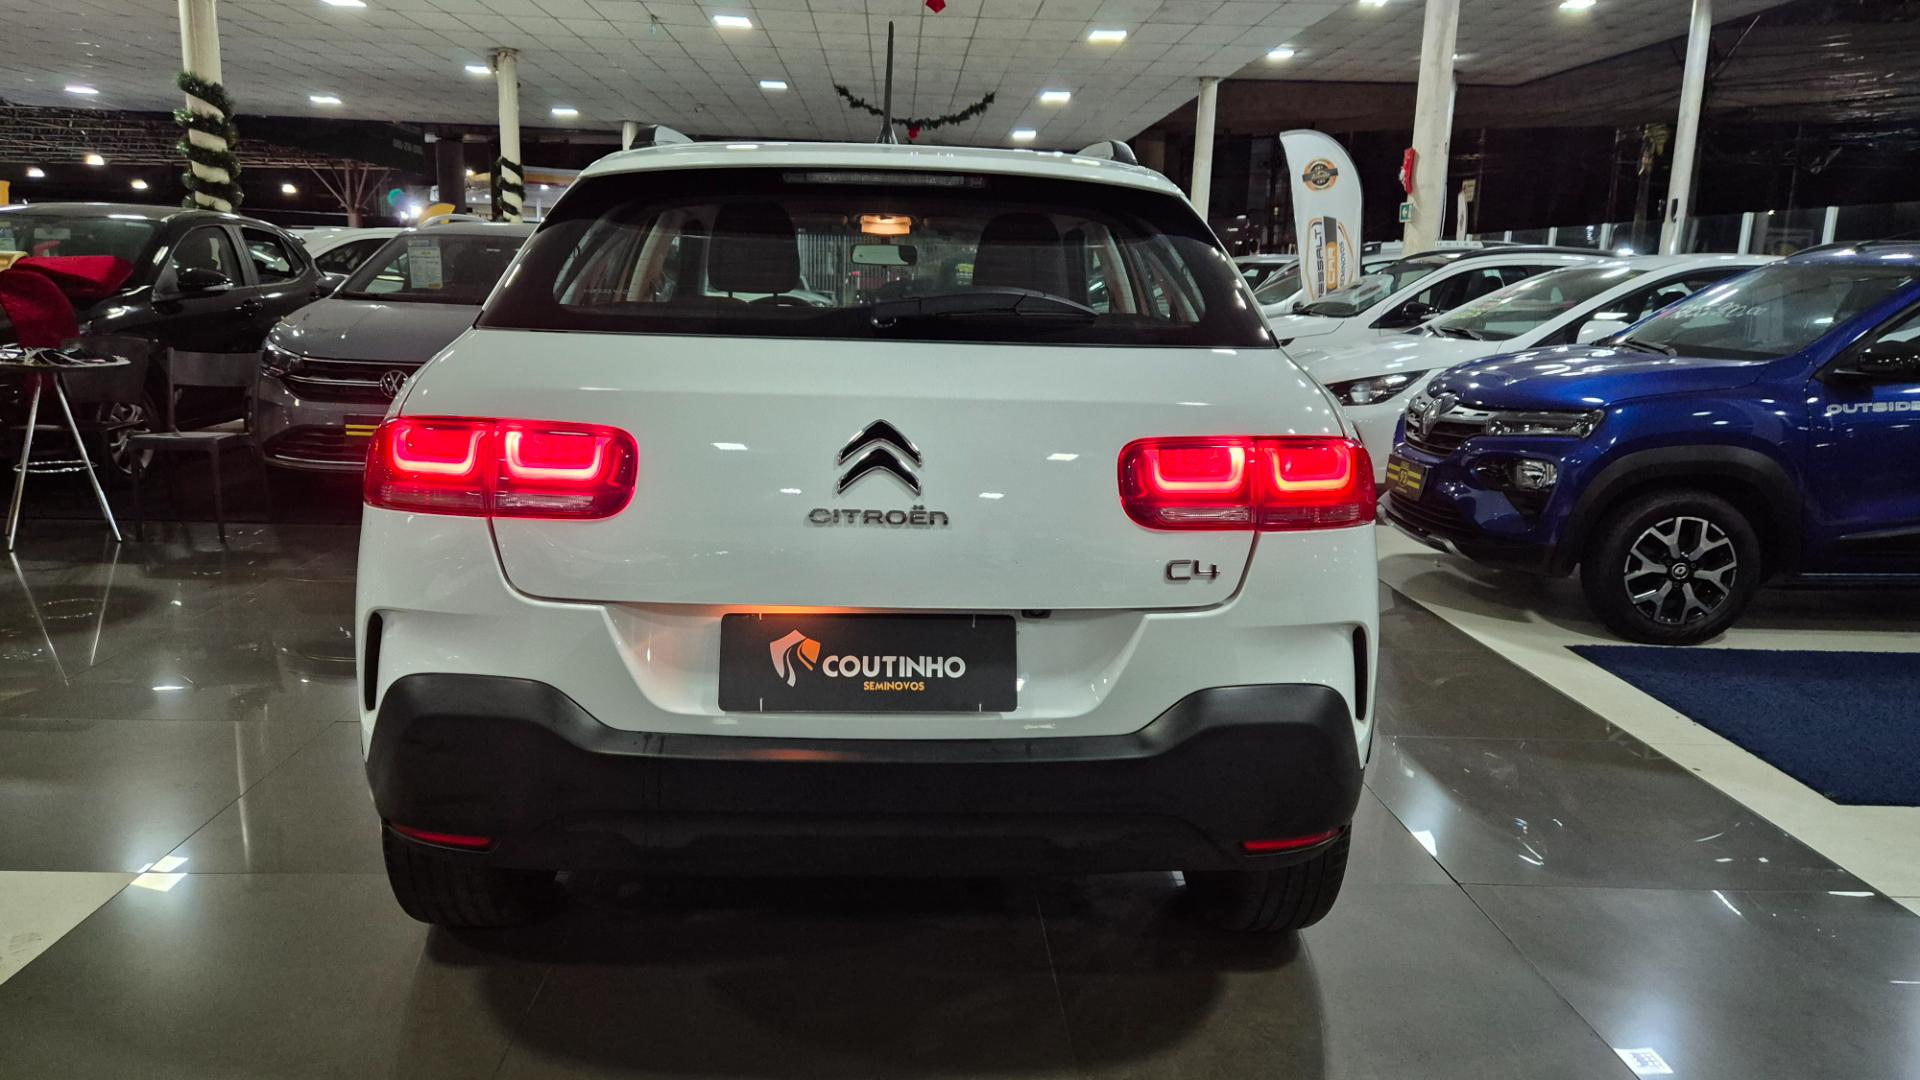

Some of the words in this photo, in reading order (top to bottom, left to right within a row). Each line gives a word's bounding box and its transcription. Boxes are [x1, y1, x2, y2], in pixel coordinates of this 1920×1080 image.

[1166, 559, 1221, 580] C4
[822, 655, 966, 679] COUTINHO
[863, 681, 925, 691] SEMINOVOS
